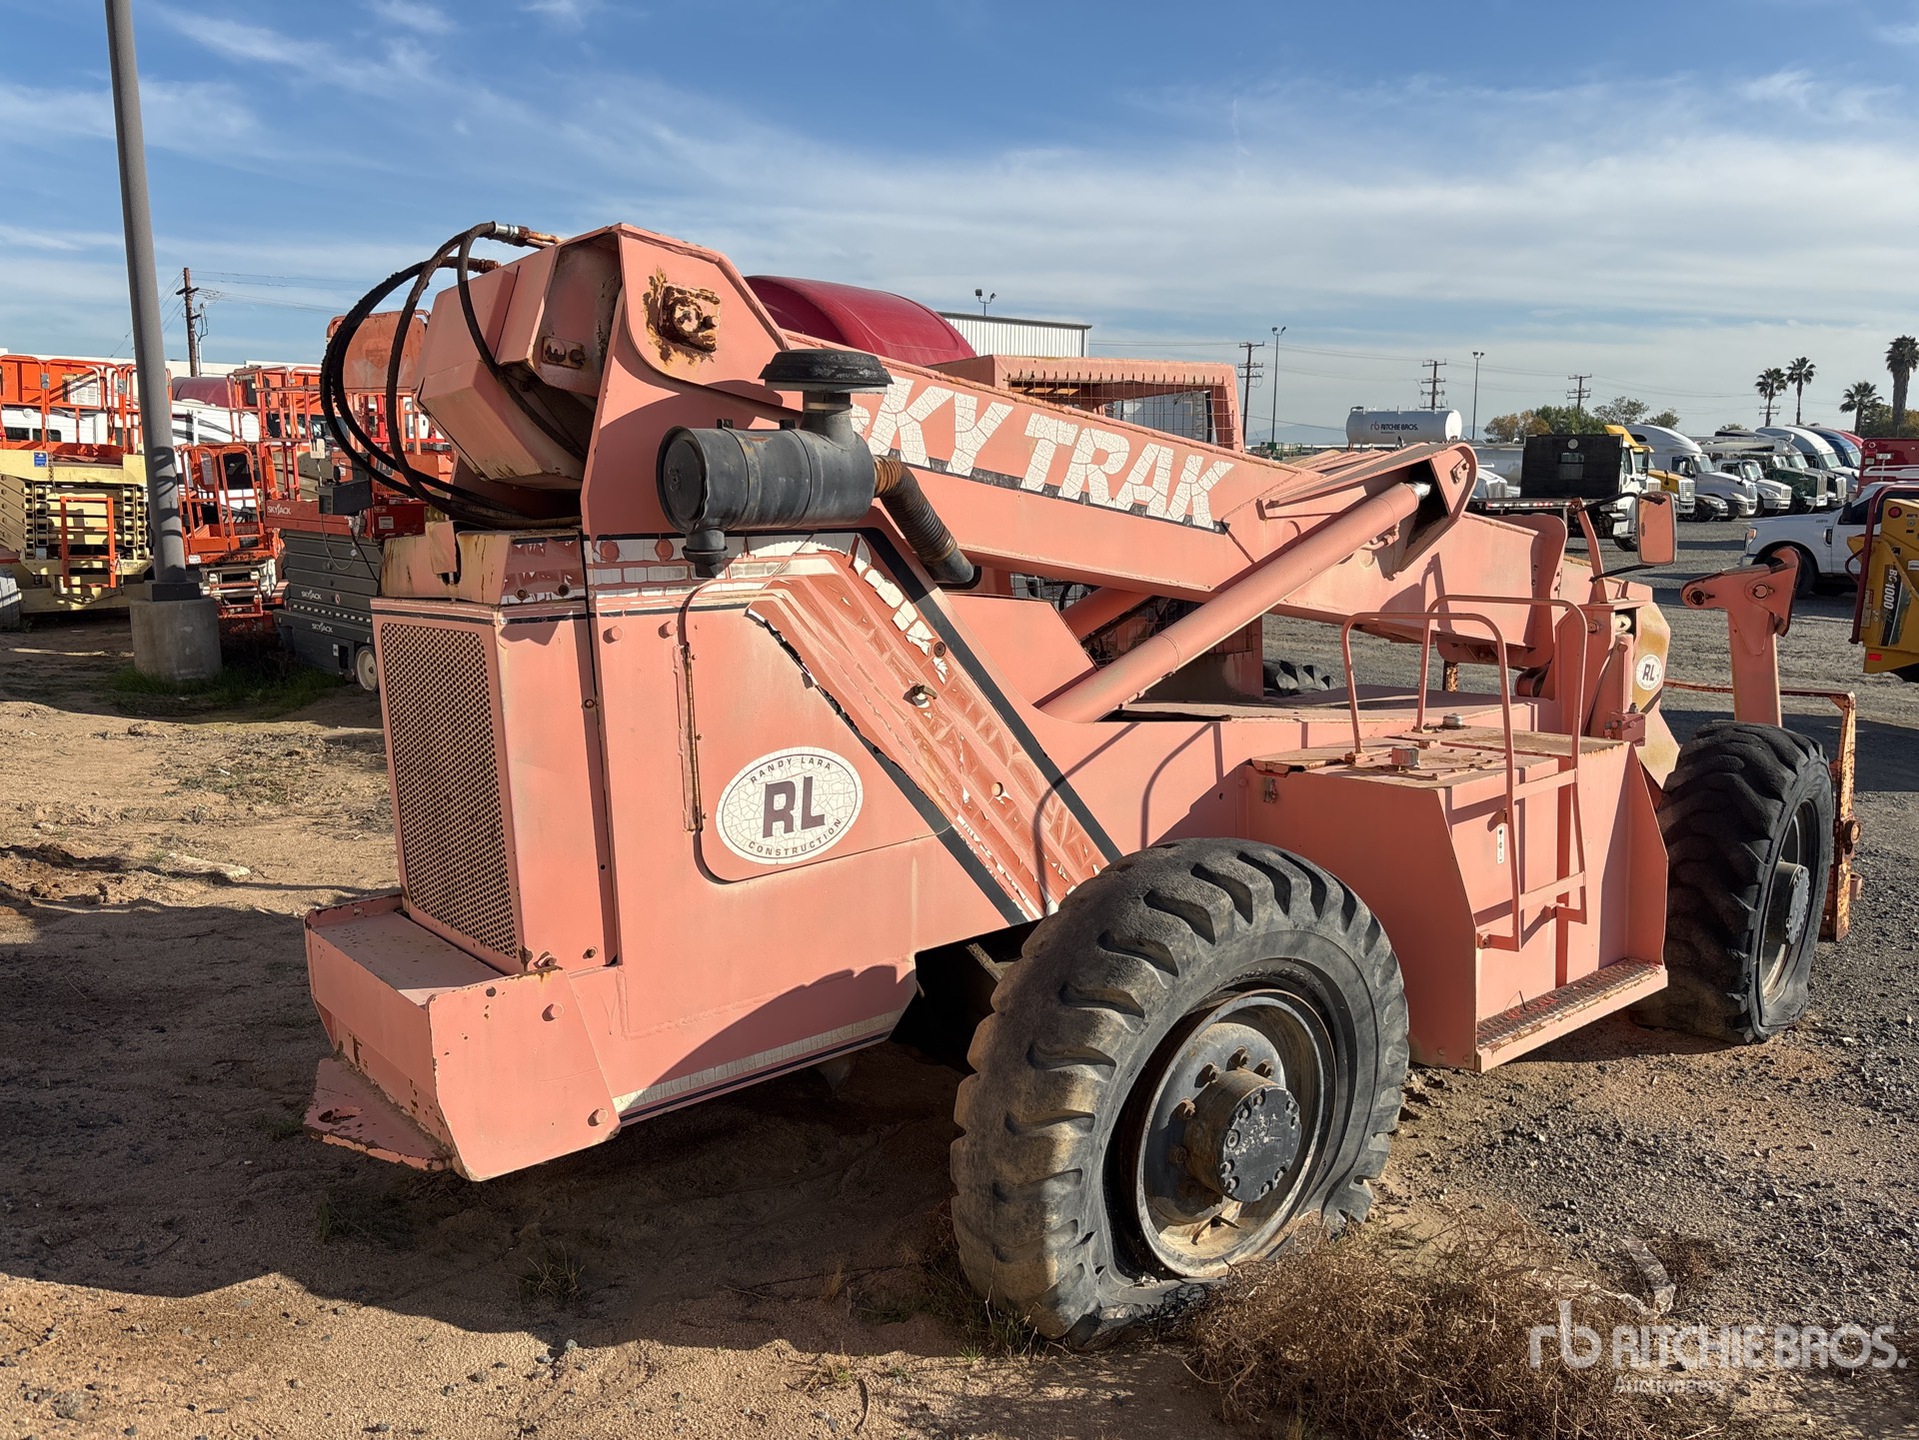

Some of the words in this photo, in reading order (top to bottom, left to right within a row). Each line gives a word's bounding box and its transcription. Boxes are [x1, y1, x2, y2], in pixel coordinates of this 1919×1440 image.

[1380, 423, 1400, 431] RITCHIE
[1401, 423, 1418, 431] BROS.
[1020, 412, 1235, 531] TRAK
[267, 503, 292, 516] SKYJACK
[301, 590, 322, 601] SKYJACK
[311, 622, 334, 634] SKYJACK
[1642, 663, 1655, 681] RL
[750, 757, 793, 784] RANDY
[801, 757, 831, 770] LARA
[762, 775, 826, 838] RL
[748, 818, 842, 857] CONSTRUCTION
